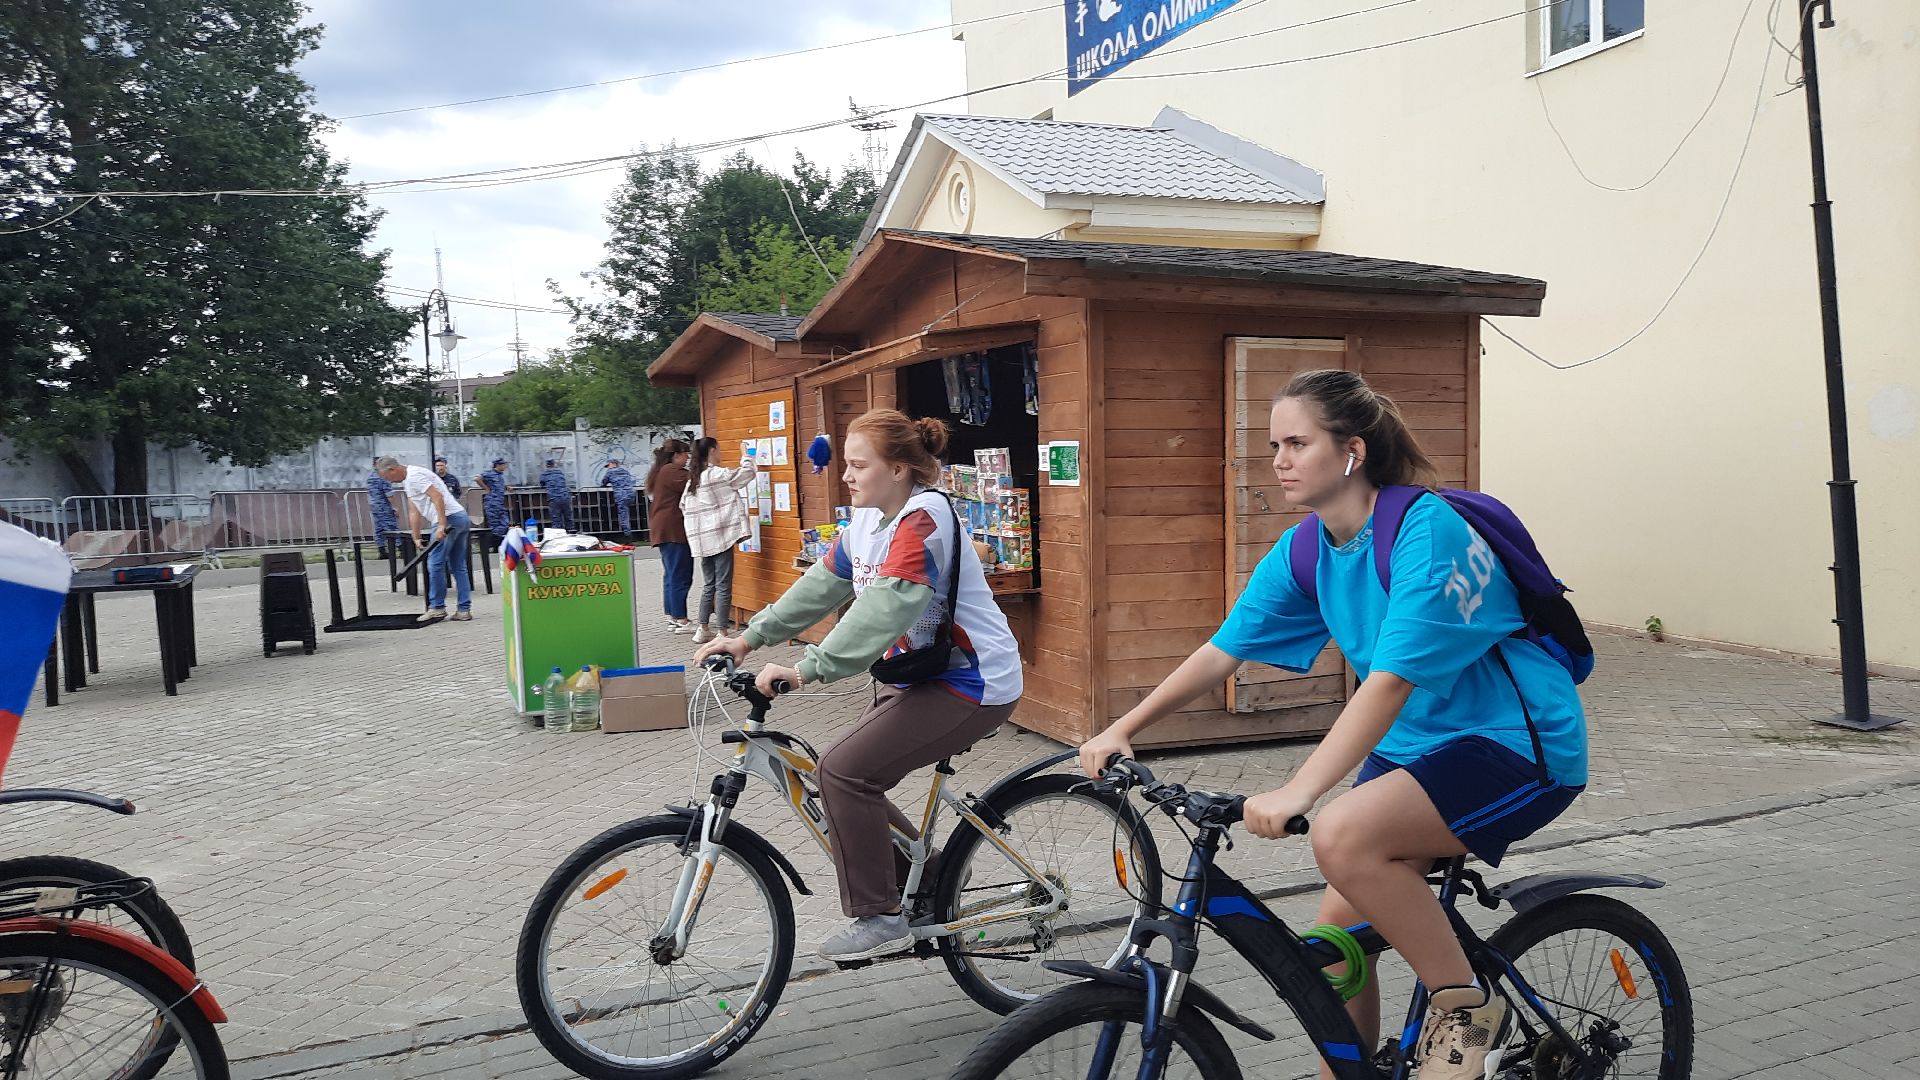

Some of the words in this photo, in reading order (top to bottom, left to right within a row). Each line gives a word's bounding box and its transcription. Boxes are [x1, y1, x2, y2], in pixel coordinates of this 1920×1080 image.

[1076, 24, 1139, 82] ШКОЛА
[1142, 0, 1217, 42] ОЛИМ
[527, 581, 623, 600] КУКУРУЗА
[534, 563, 616, 579] ОРЯЧАЯ
[1250, 927, 1342, 1036] STELS
[713, 1001, 769, 1059] STELS
